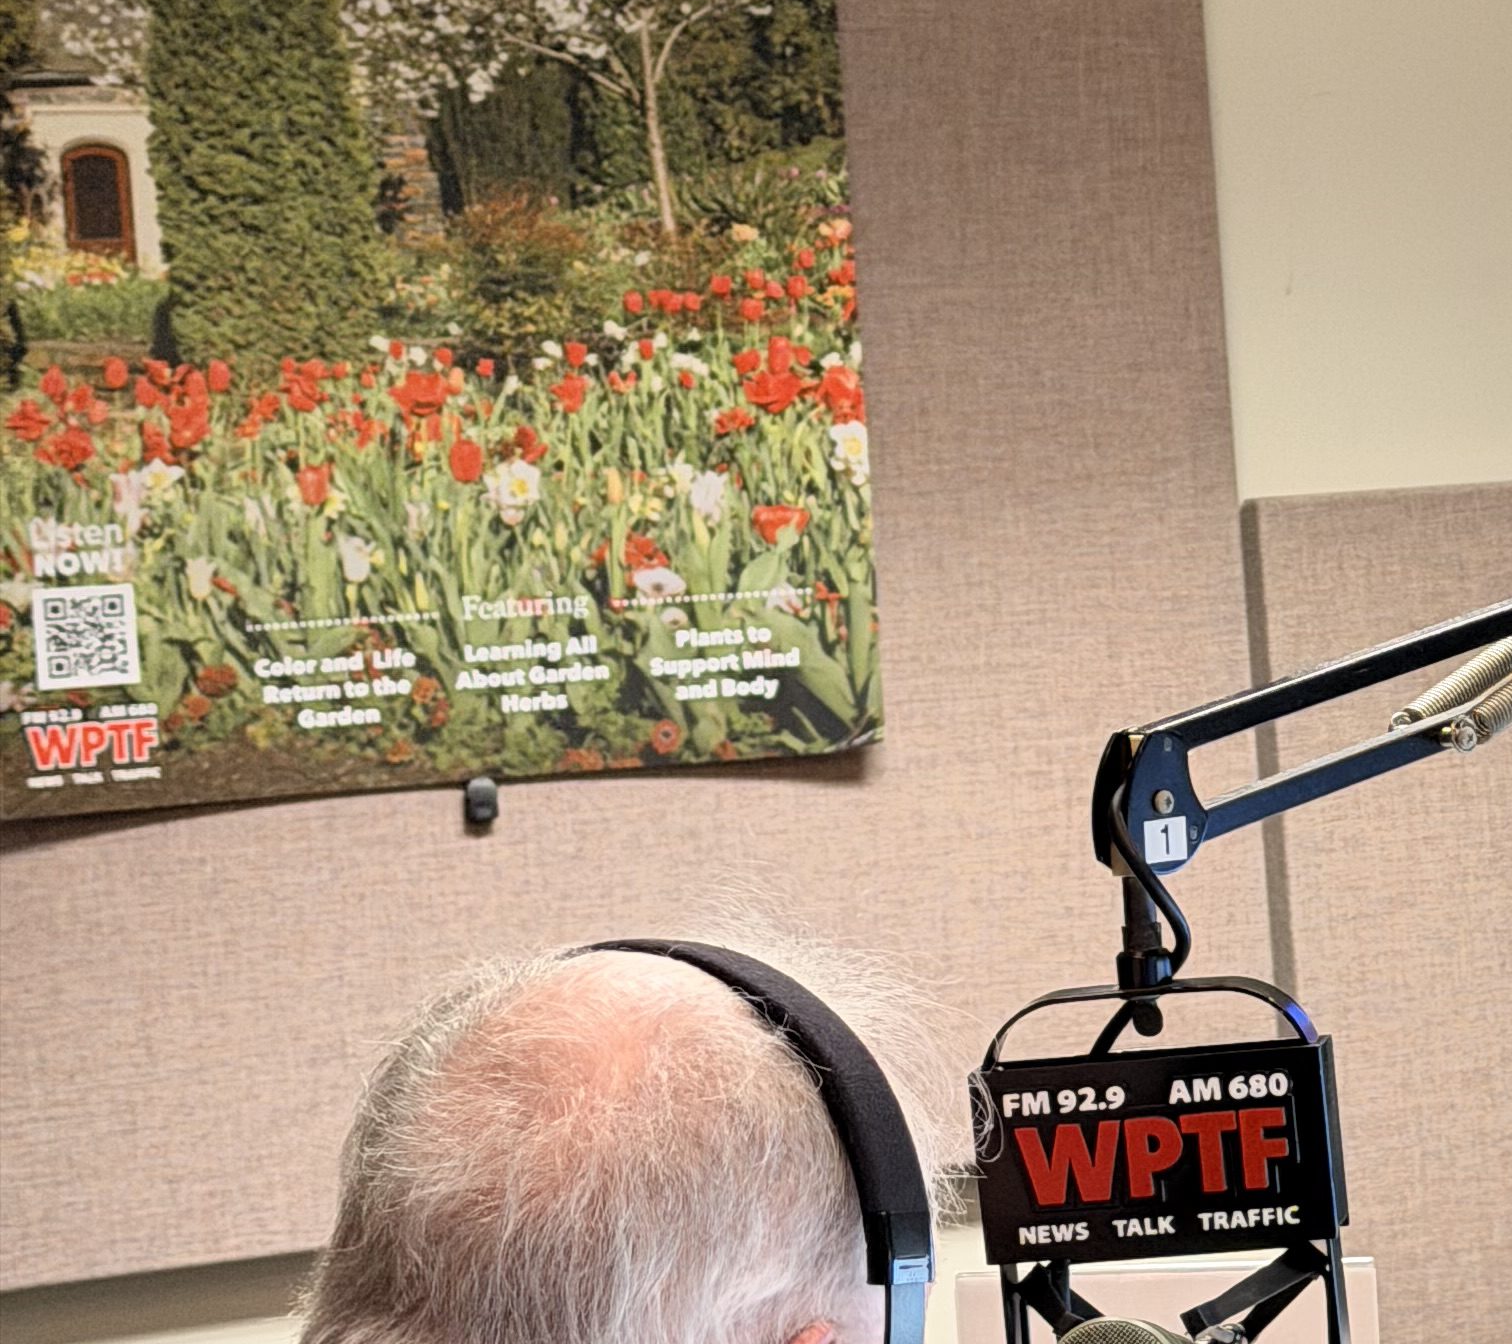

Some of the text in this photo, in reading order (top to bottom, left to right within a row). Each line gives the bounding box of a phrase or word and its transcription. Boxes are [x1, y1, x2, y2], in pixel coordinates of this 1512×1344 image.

[462, 591, 590, 621] Featuring
[464, 635, 598, 663] Learning All
[675, 626, 773, 649] Plants to
[254, 648, 417, 678] Color and Life
[455, 663, 610, 691] About Garden
[650, 647, 800, 679] Support Mind
[262, 676, 413, 704] Return to the
[501, 691, 568, 713] Herbs
[675, 675, 780, 700] and Body
[297, 706, 381, 729] Garden
[26, 719, 158, 770] WPTF
[1160, 823, 1170, 855] 1
[1002, 1072, 1289, 1118] FM 92.9 AM 680
[1014, 1107, 1290, 1207] WPTF
[1018, 1205, 1301, 1246] NEWS TALK TRAFFIC
